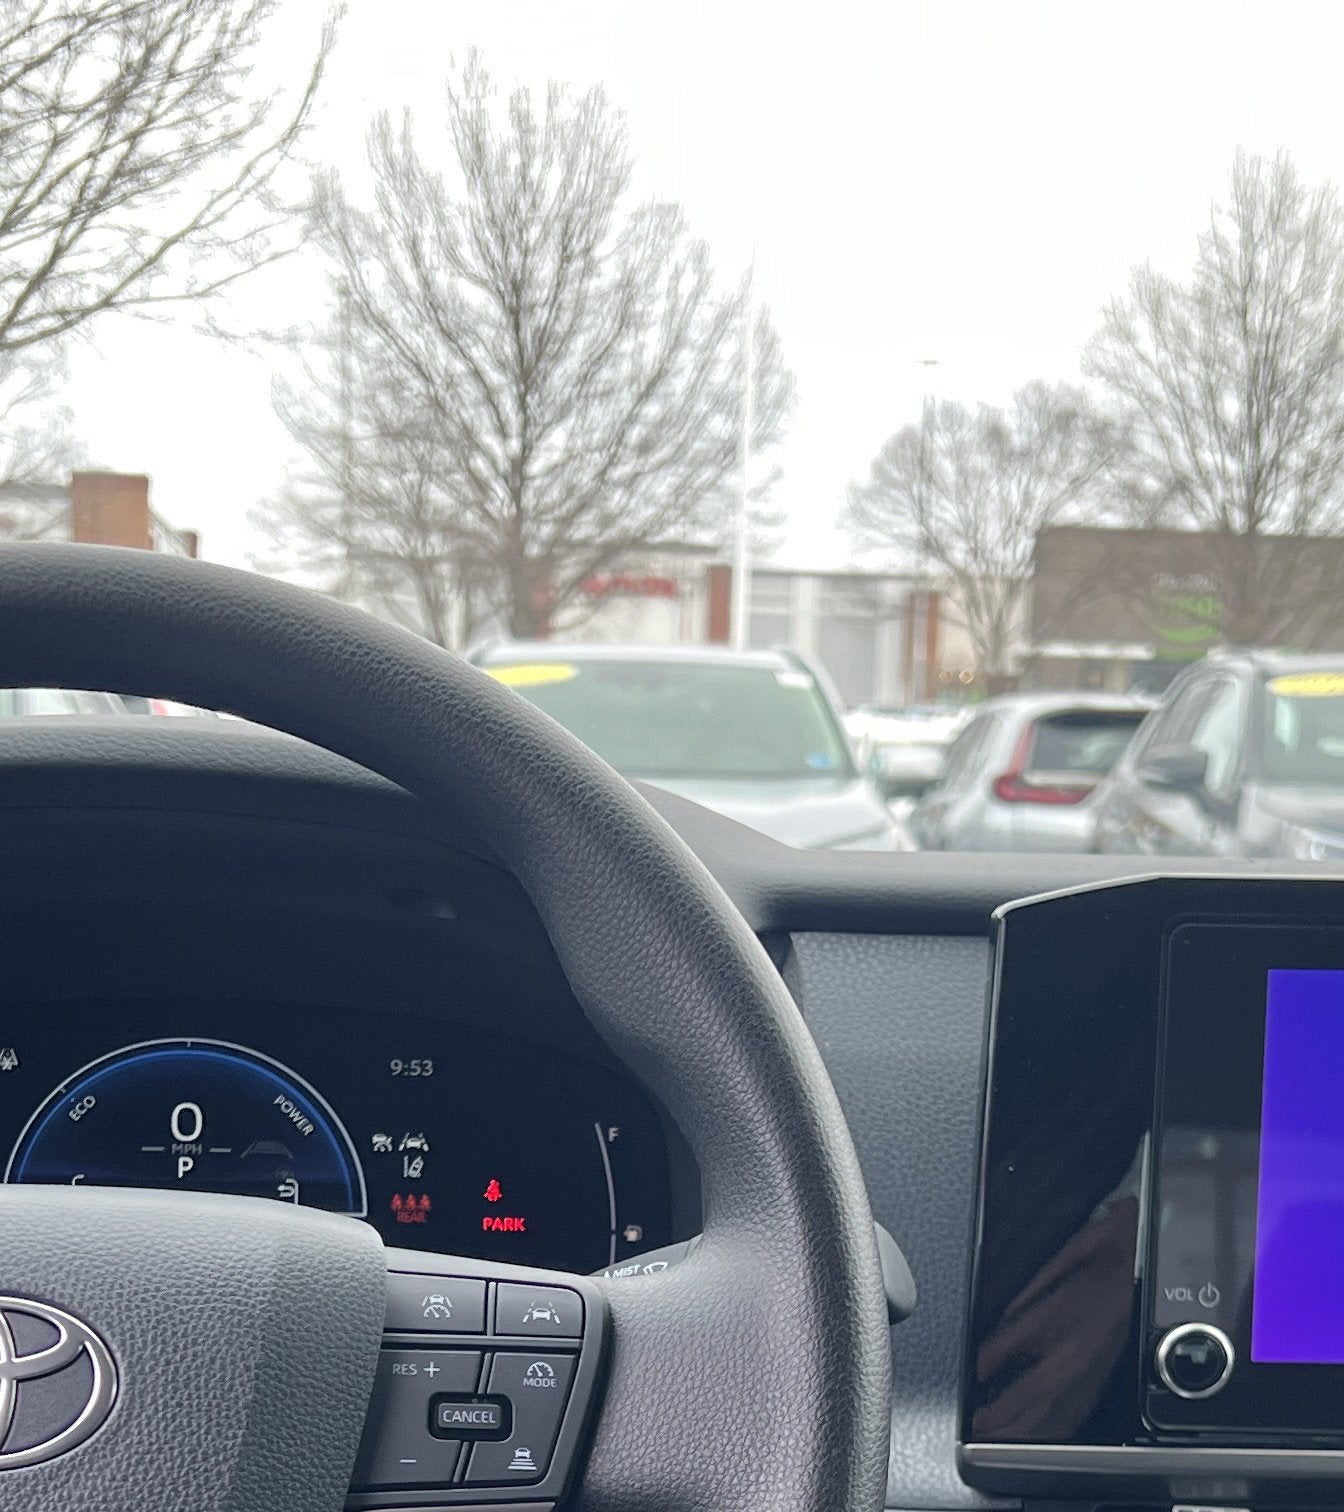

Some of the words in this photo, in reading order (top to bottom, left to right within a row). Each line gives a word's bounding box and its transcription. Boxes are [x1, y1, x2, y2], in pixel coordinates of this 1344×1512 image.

[389, 1059, 434, 1077] 9:53
[68, 1095, 97, 1122] ECO
[273, 1094, 316, 1137] POWER
[608, 1127, 620, 1142] F
[171, 1143, 202, 1156] MPH
[177, 1156, 194, 1179] P
[482, 1216, 526, 1232] PARK
[1164, 1287, 1194, 1301] VOL
[392, 1363, 418, 1376] RES
[522, 1377, 557, 1388] MODE
[442, 1409, 497, 1424] CANCEL
